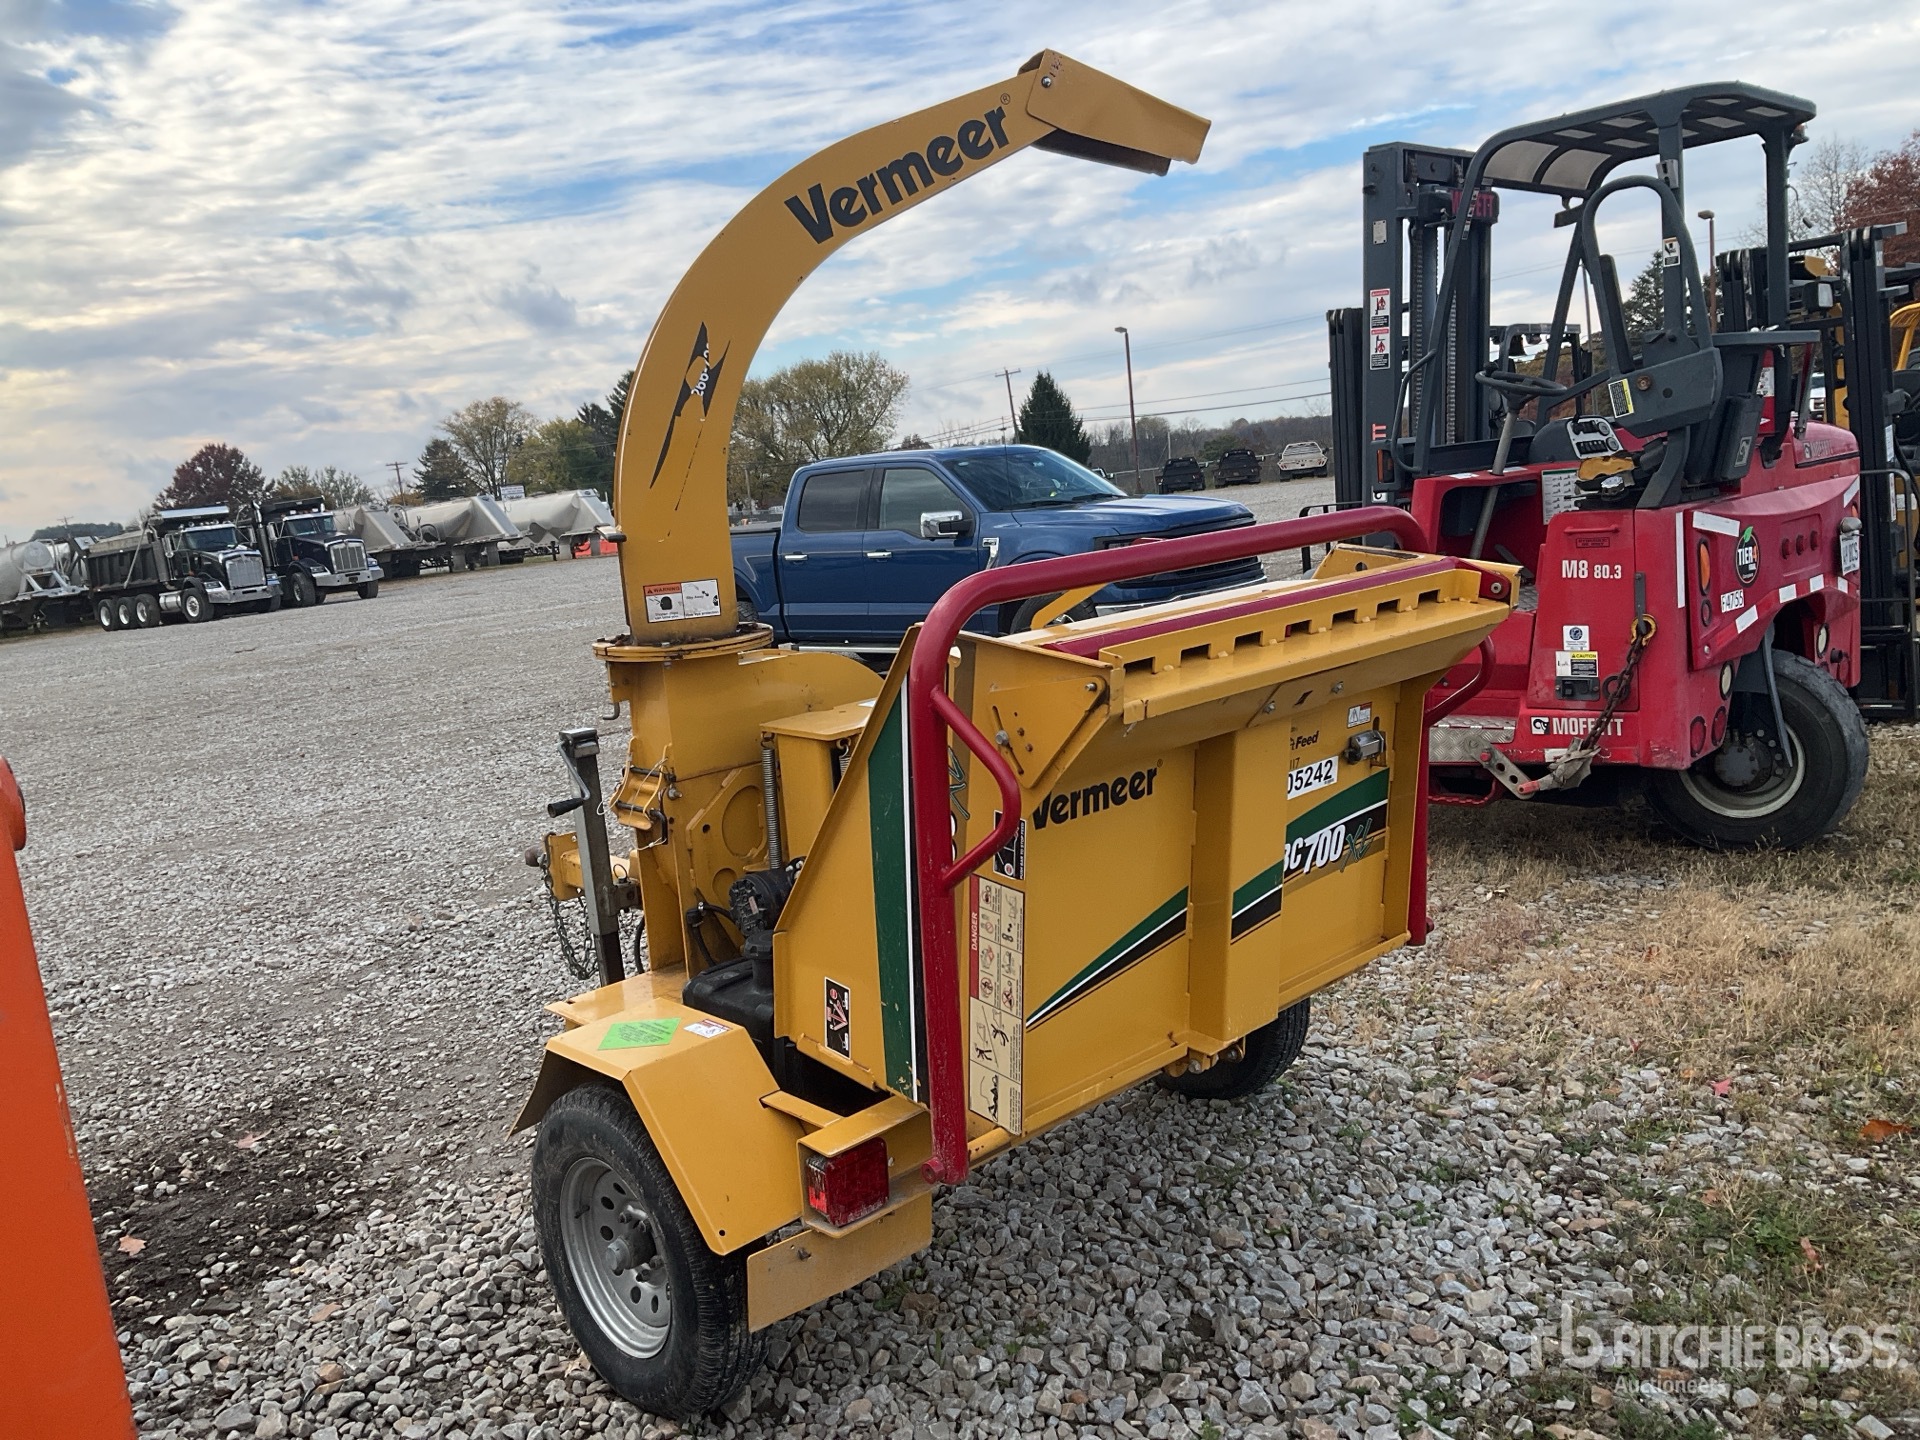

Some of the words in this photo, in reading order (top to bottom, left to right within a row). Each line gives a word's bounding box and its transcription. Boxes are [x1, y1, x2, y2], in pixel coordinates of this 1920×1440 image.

[784, 106, 1009, 244] Vermeer
[1562, 559, 1589, 579] M8
[1593, 564, 1622, 579] 80.3
[1552, 717, 1624, 737] MOFFTT
[1032, 766, 1158, 831] Vermeer
